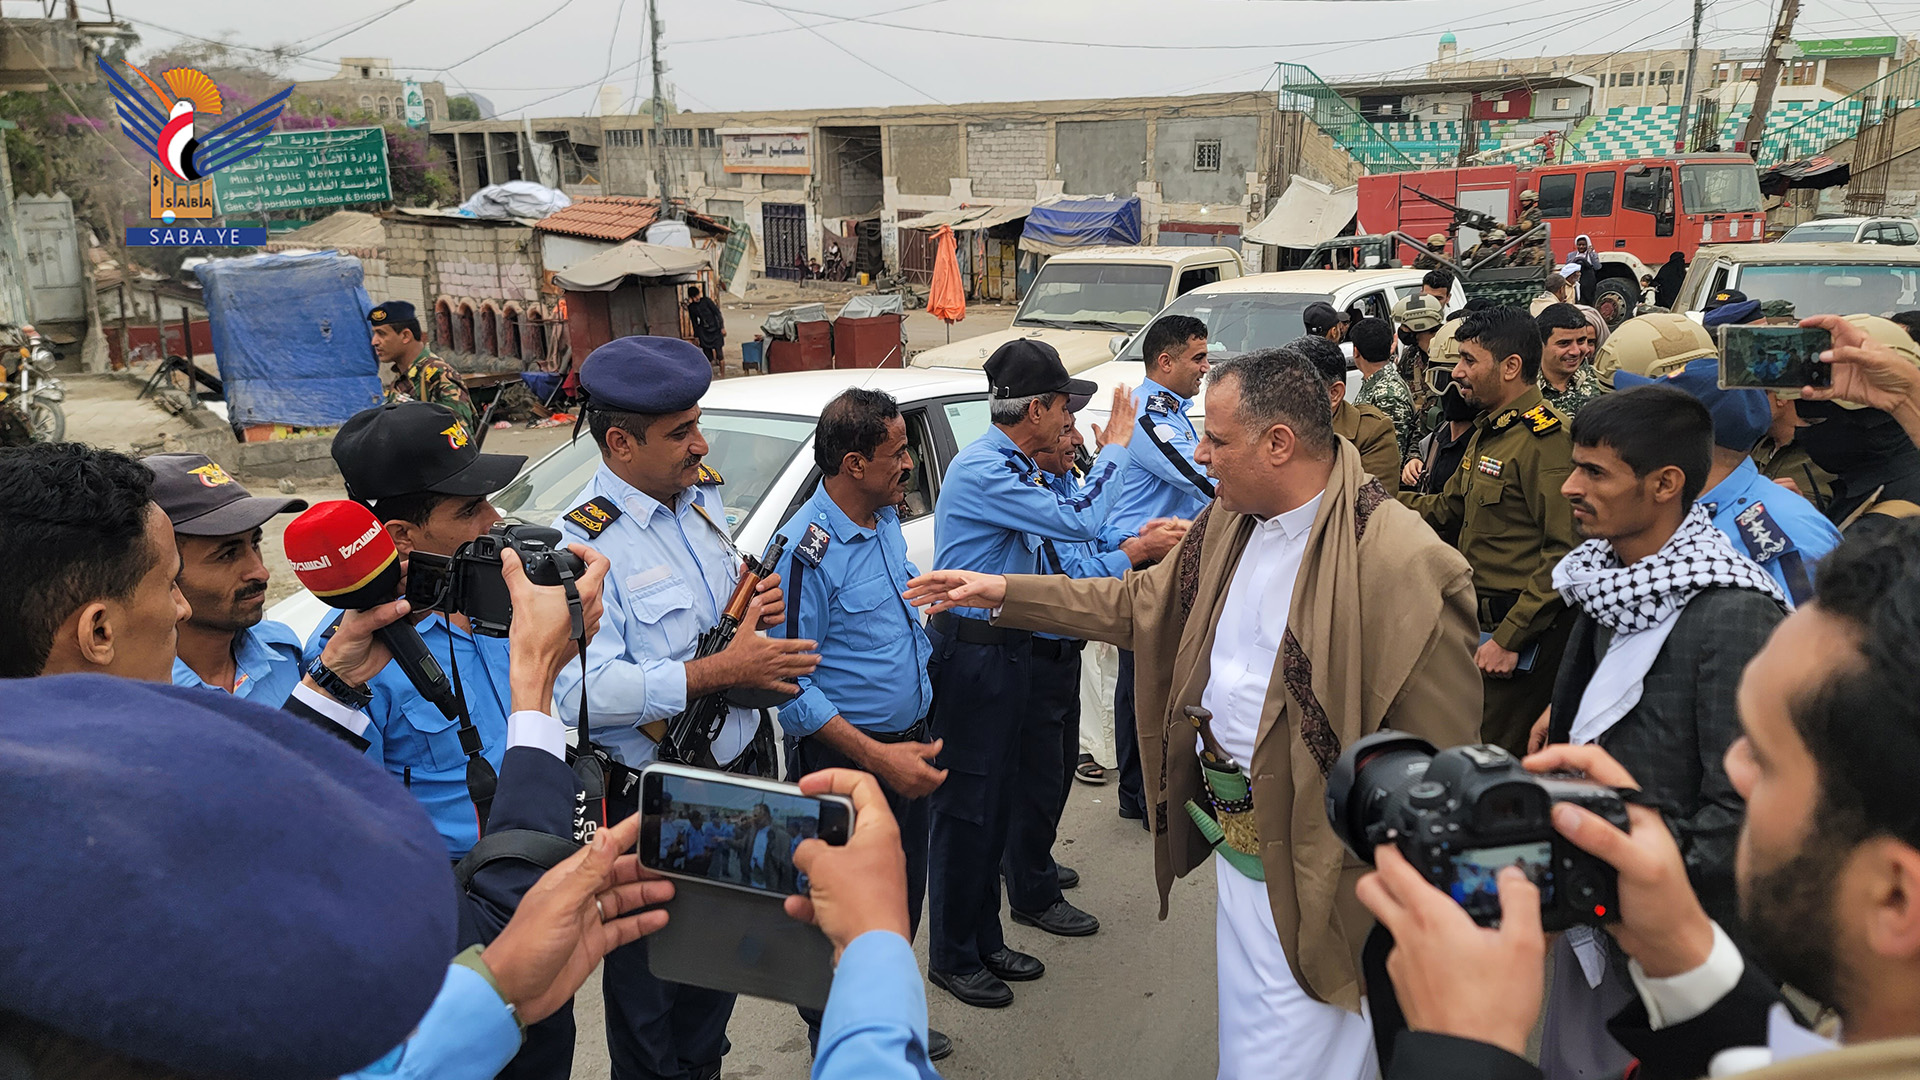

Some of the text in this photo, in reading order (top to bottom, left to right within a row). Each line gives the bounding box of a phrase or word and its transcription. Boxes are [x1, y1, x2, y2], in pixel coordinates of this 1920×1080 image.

[290, 130, 368, 146] الجمهورية
[221, 158, 270, 173] والطرق
[272, 156, 303, 168] العامة
[350, 153, 378, 164] وزارة
[230, 175, 253, 184] Min.
[255, 174, 265, 183] of
[268, 171, 301, 182] Public
[307, 169, 340, 179] Works
[344, 167, 354, 176] &
[222, 176, 383, 200] المؤسسة العامة للطرق والجسور
[247, 199, 301, 211] Cporation
[304, 197, 316, 206] for
[318, 194, 343, 204] Roads
[345, 192, 354, 202] &
[354, 191, 387, 203] Bridges
